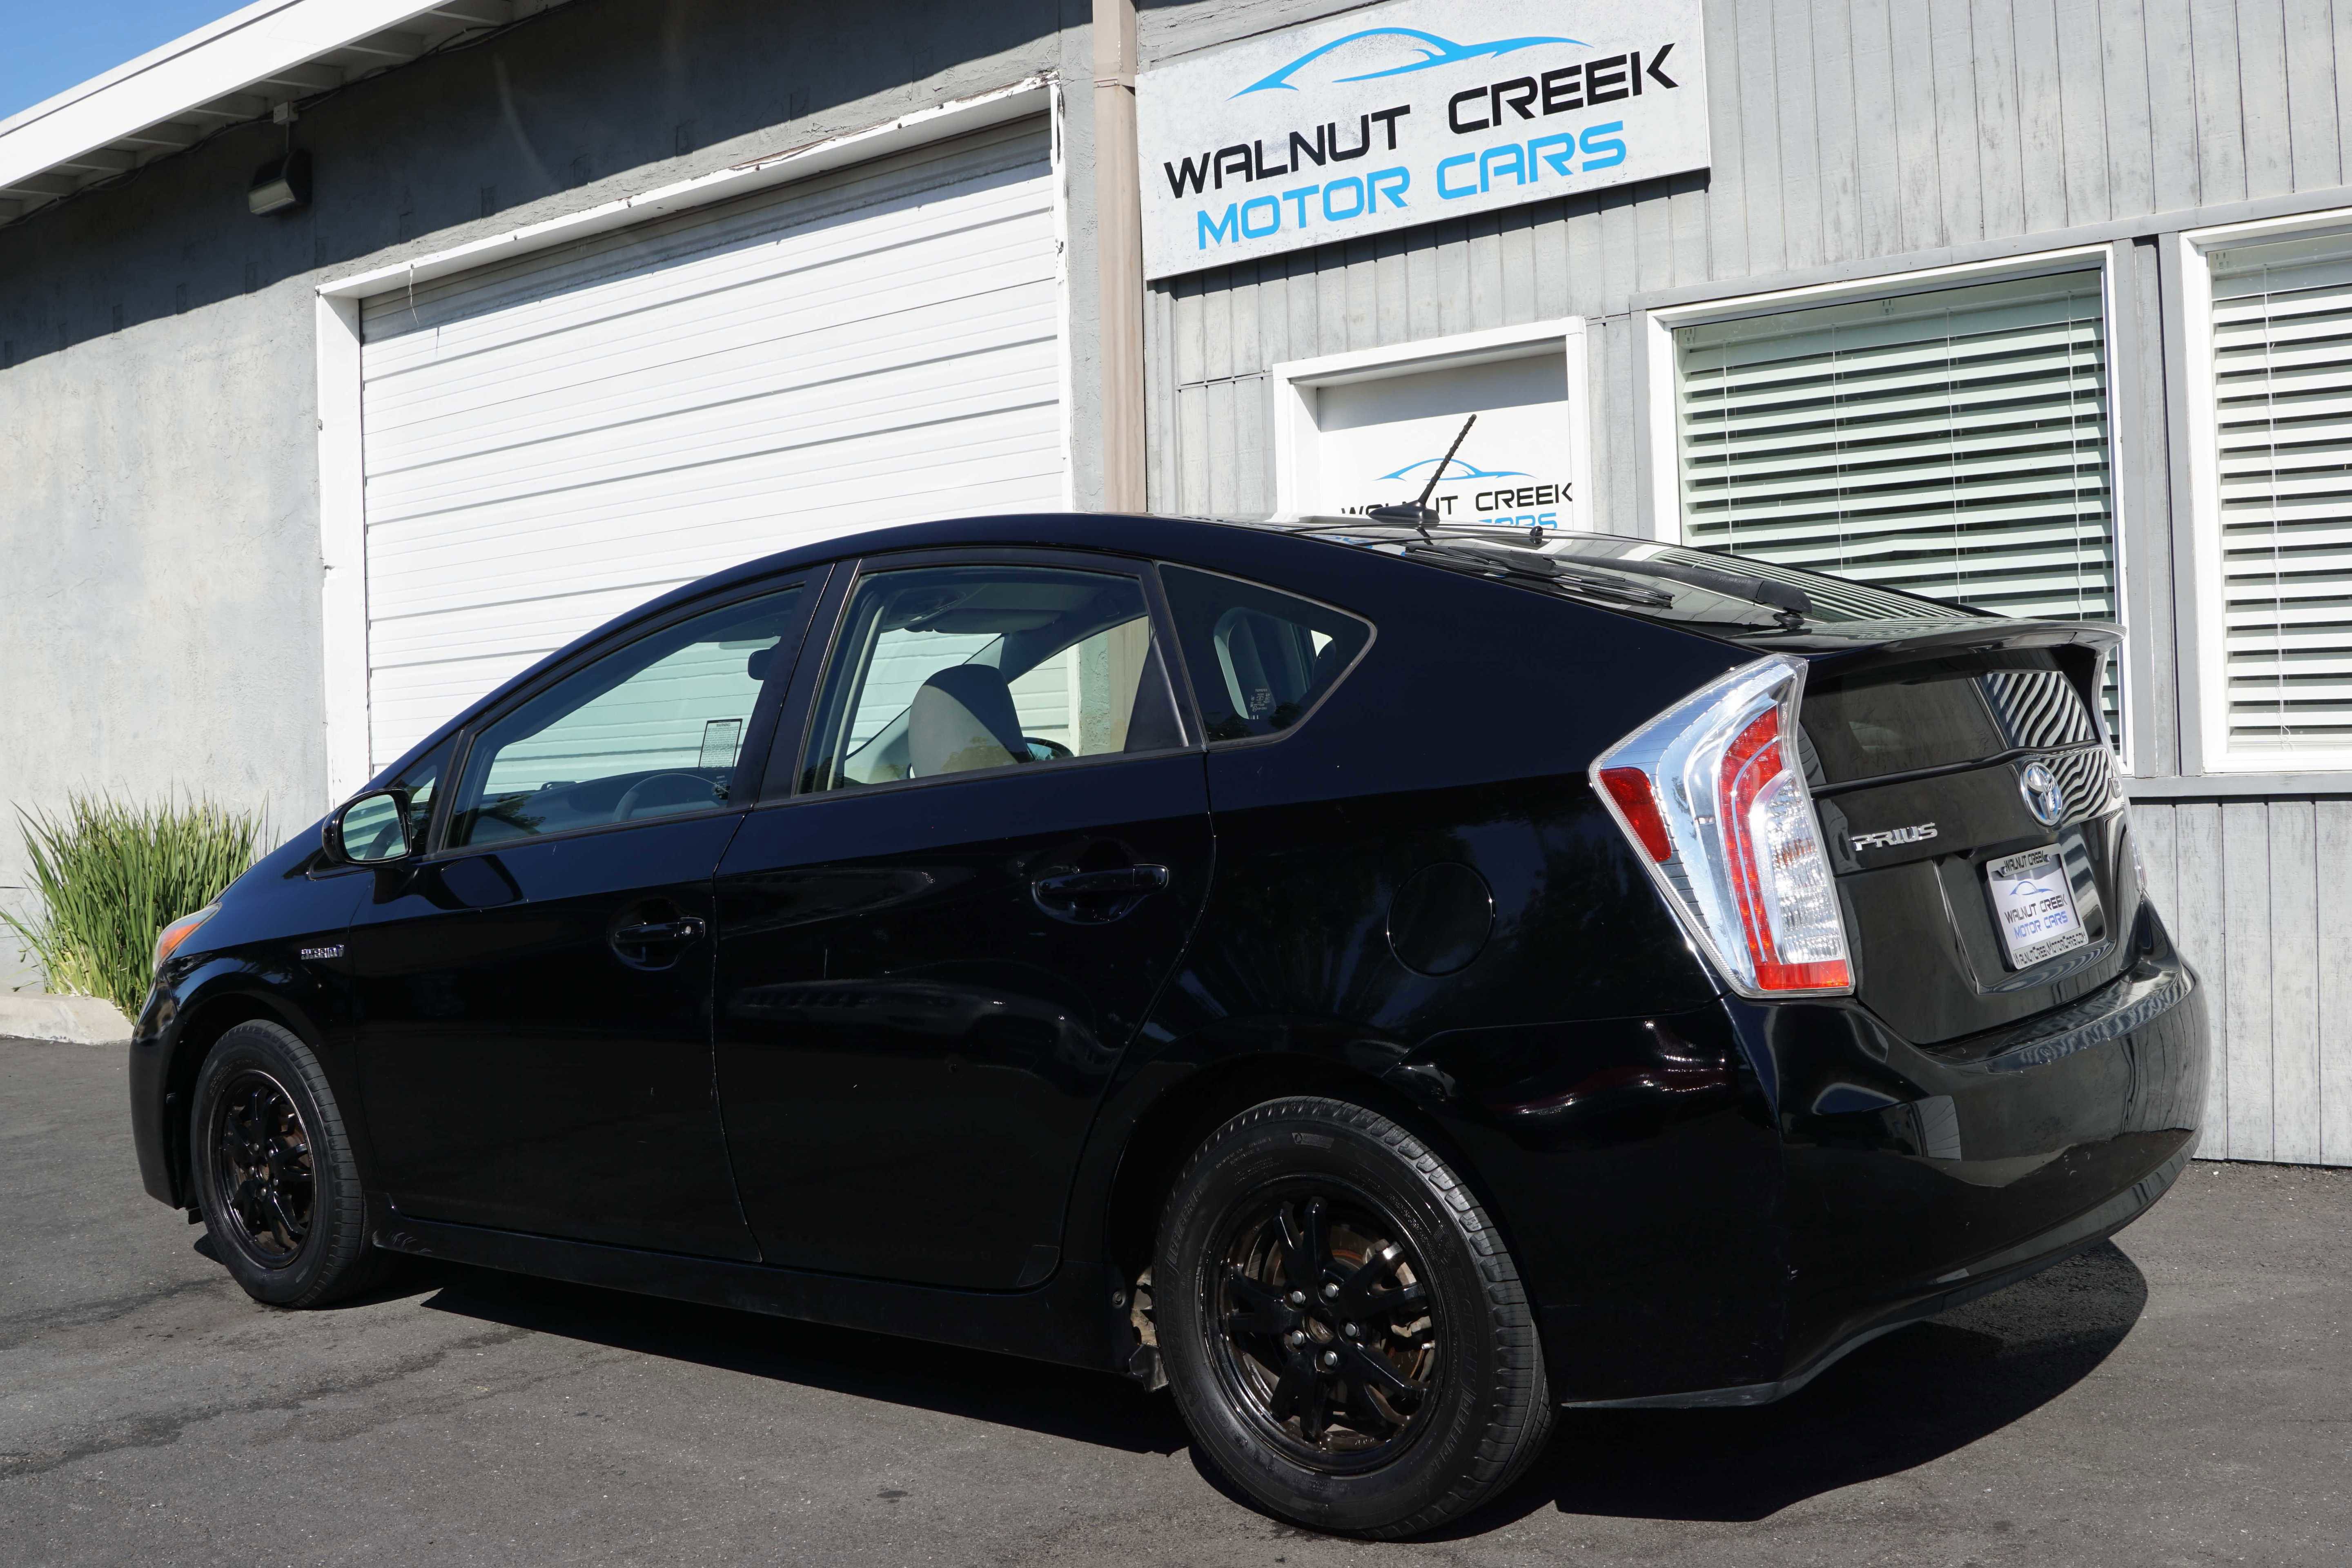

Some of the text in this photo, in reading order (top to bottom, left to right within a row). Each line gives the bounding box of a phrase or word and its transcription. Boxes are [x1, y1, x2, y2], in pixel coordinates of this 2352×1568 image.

[1164, 42, 1679, 199] WALNUT CREEK
[1198, 120, 1627, 250] MOTOR CARS
[1475, 482, 1572, 511] CREEK
[1850, 822, 1938, 851] PRIUS
[2004, 850, 2046, 872] WALNUT CREEK
[2005, 894, 2068, 924] WALNUT CREEK
[2014, 911, 2068, 940] MOTOR CARS
